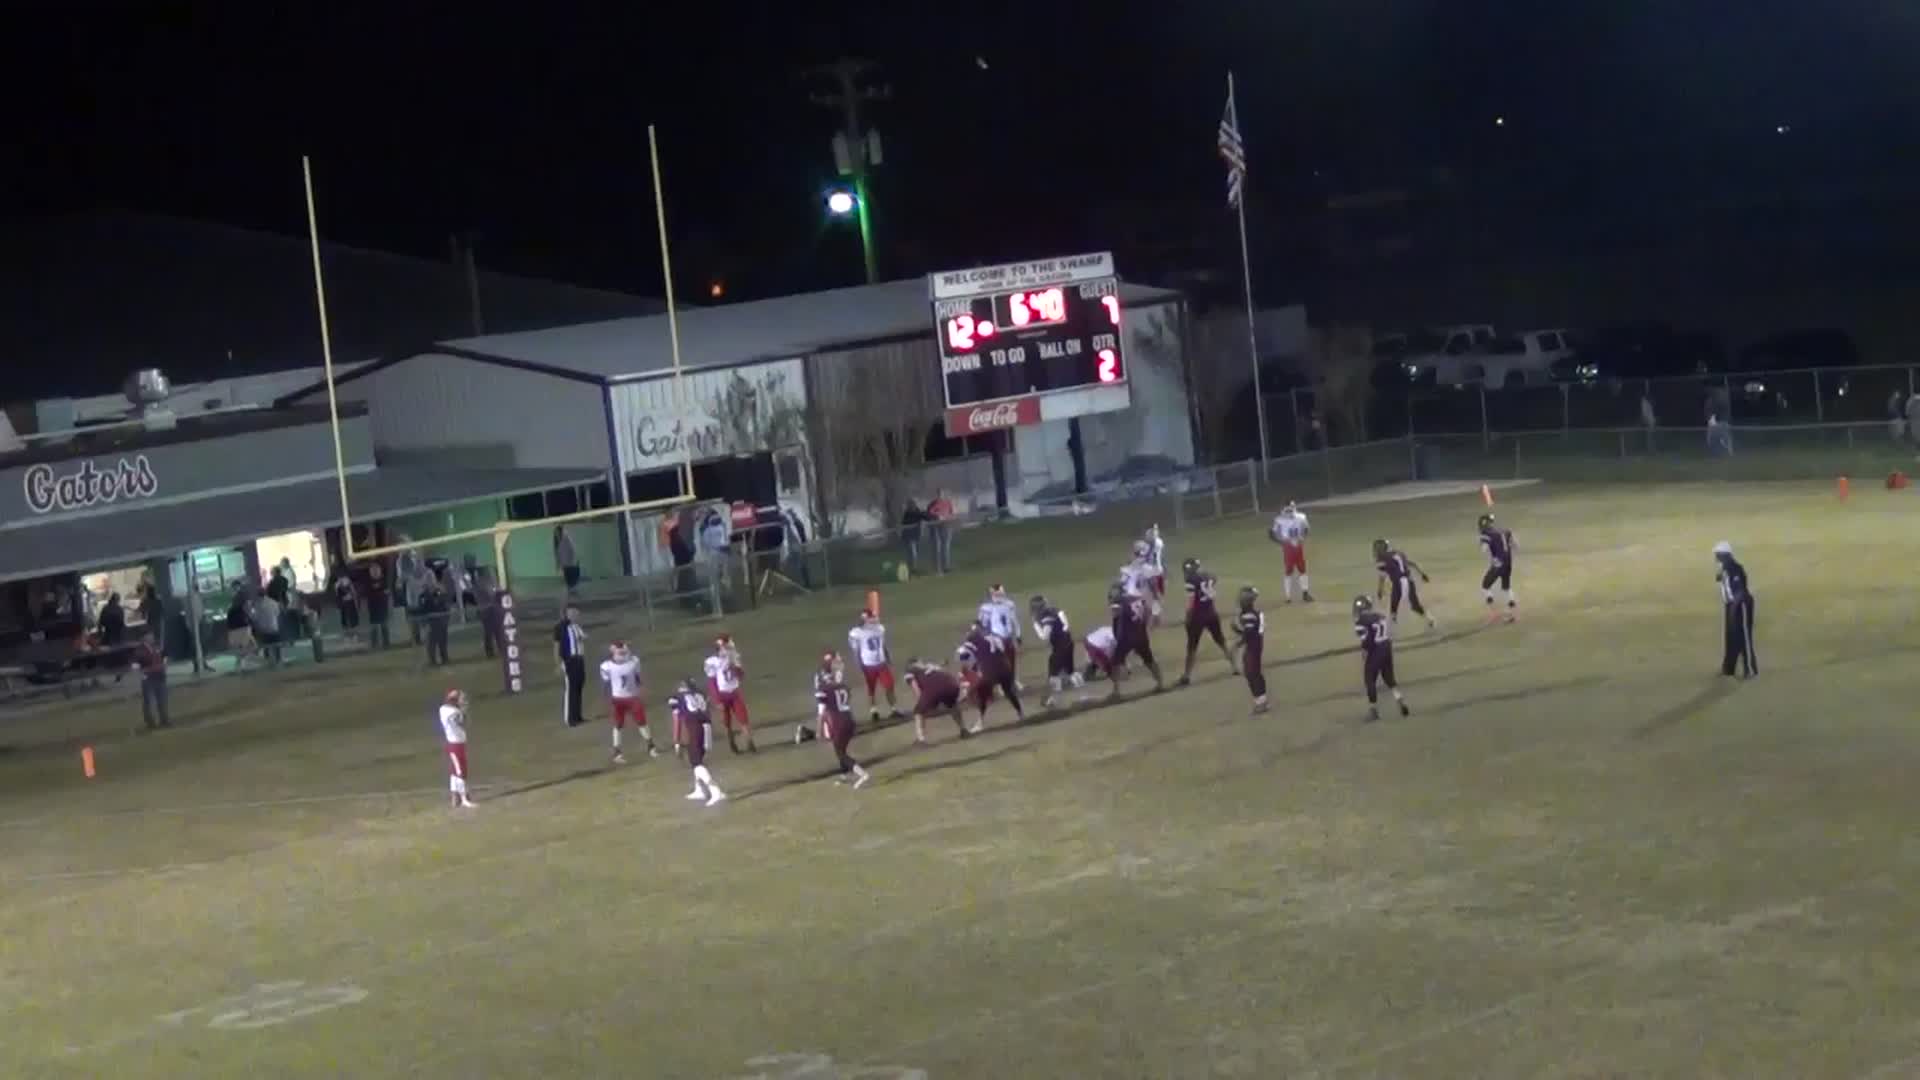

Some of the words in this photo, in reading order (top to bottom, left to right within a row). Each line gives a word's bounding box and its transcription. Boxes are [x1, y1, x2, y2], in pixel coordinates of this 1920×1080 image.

[943, 270, 1005, 286] WELCOME
[1011, 265, 1026, 276] TO
[1031, 262, 1057, 274] THE
[1058, 255, 1104, 269] SWAMP
[937, 299, 973, 318] HOME
[1102, 296, 1120, 324] 7
[948, 315, 975, 349] 12
[1092, 334, 1116, 351] QTR
[990, 350, 1006, 366] TO
[1008, 347, 1026, 363] GO
[1038, 341, 1064, 359] BALL
[1065, 339, 1082, 354] ON
[944, 354, 981, 372] DOWN
[1098, 349, 1116, 382] 2
[24, 454, 158, 514] Gators
